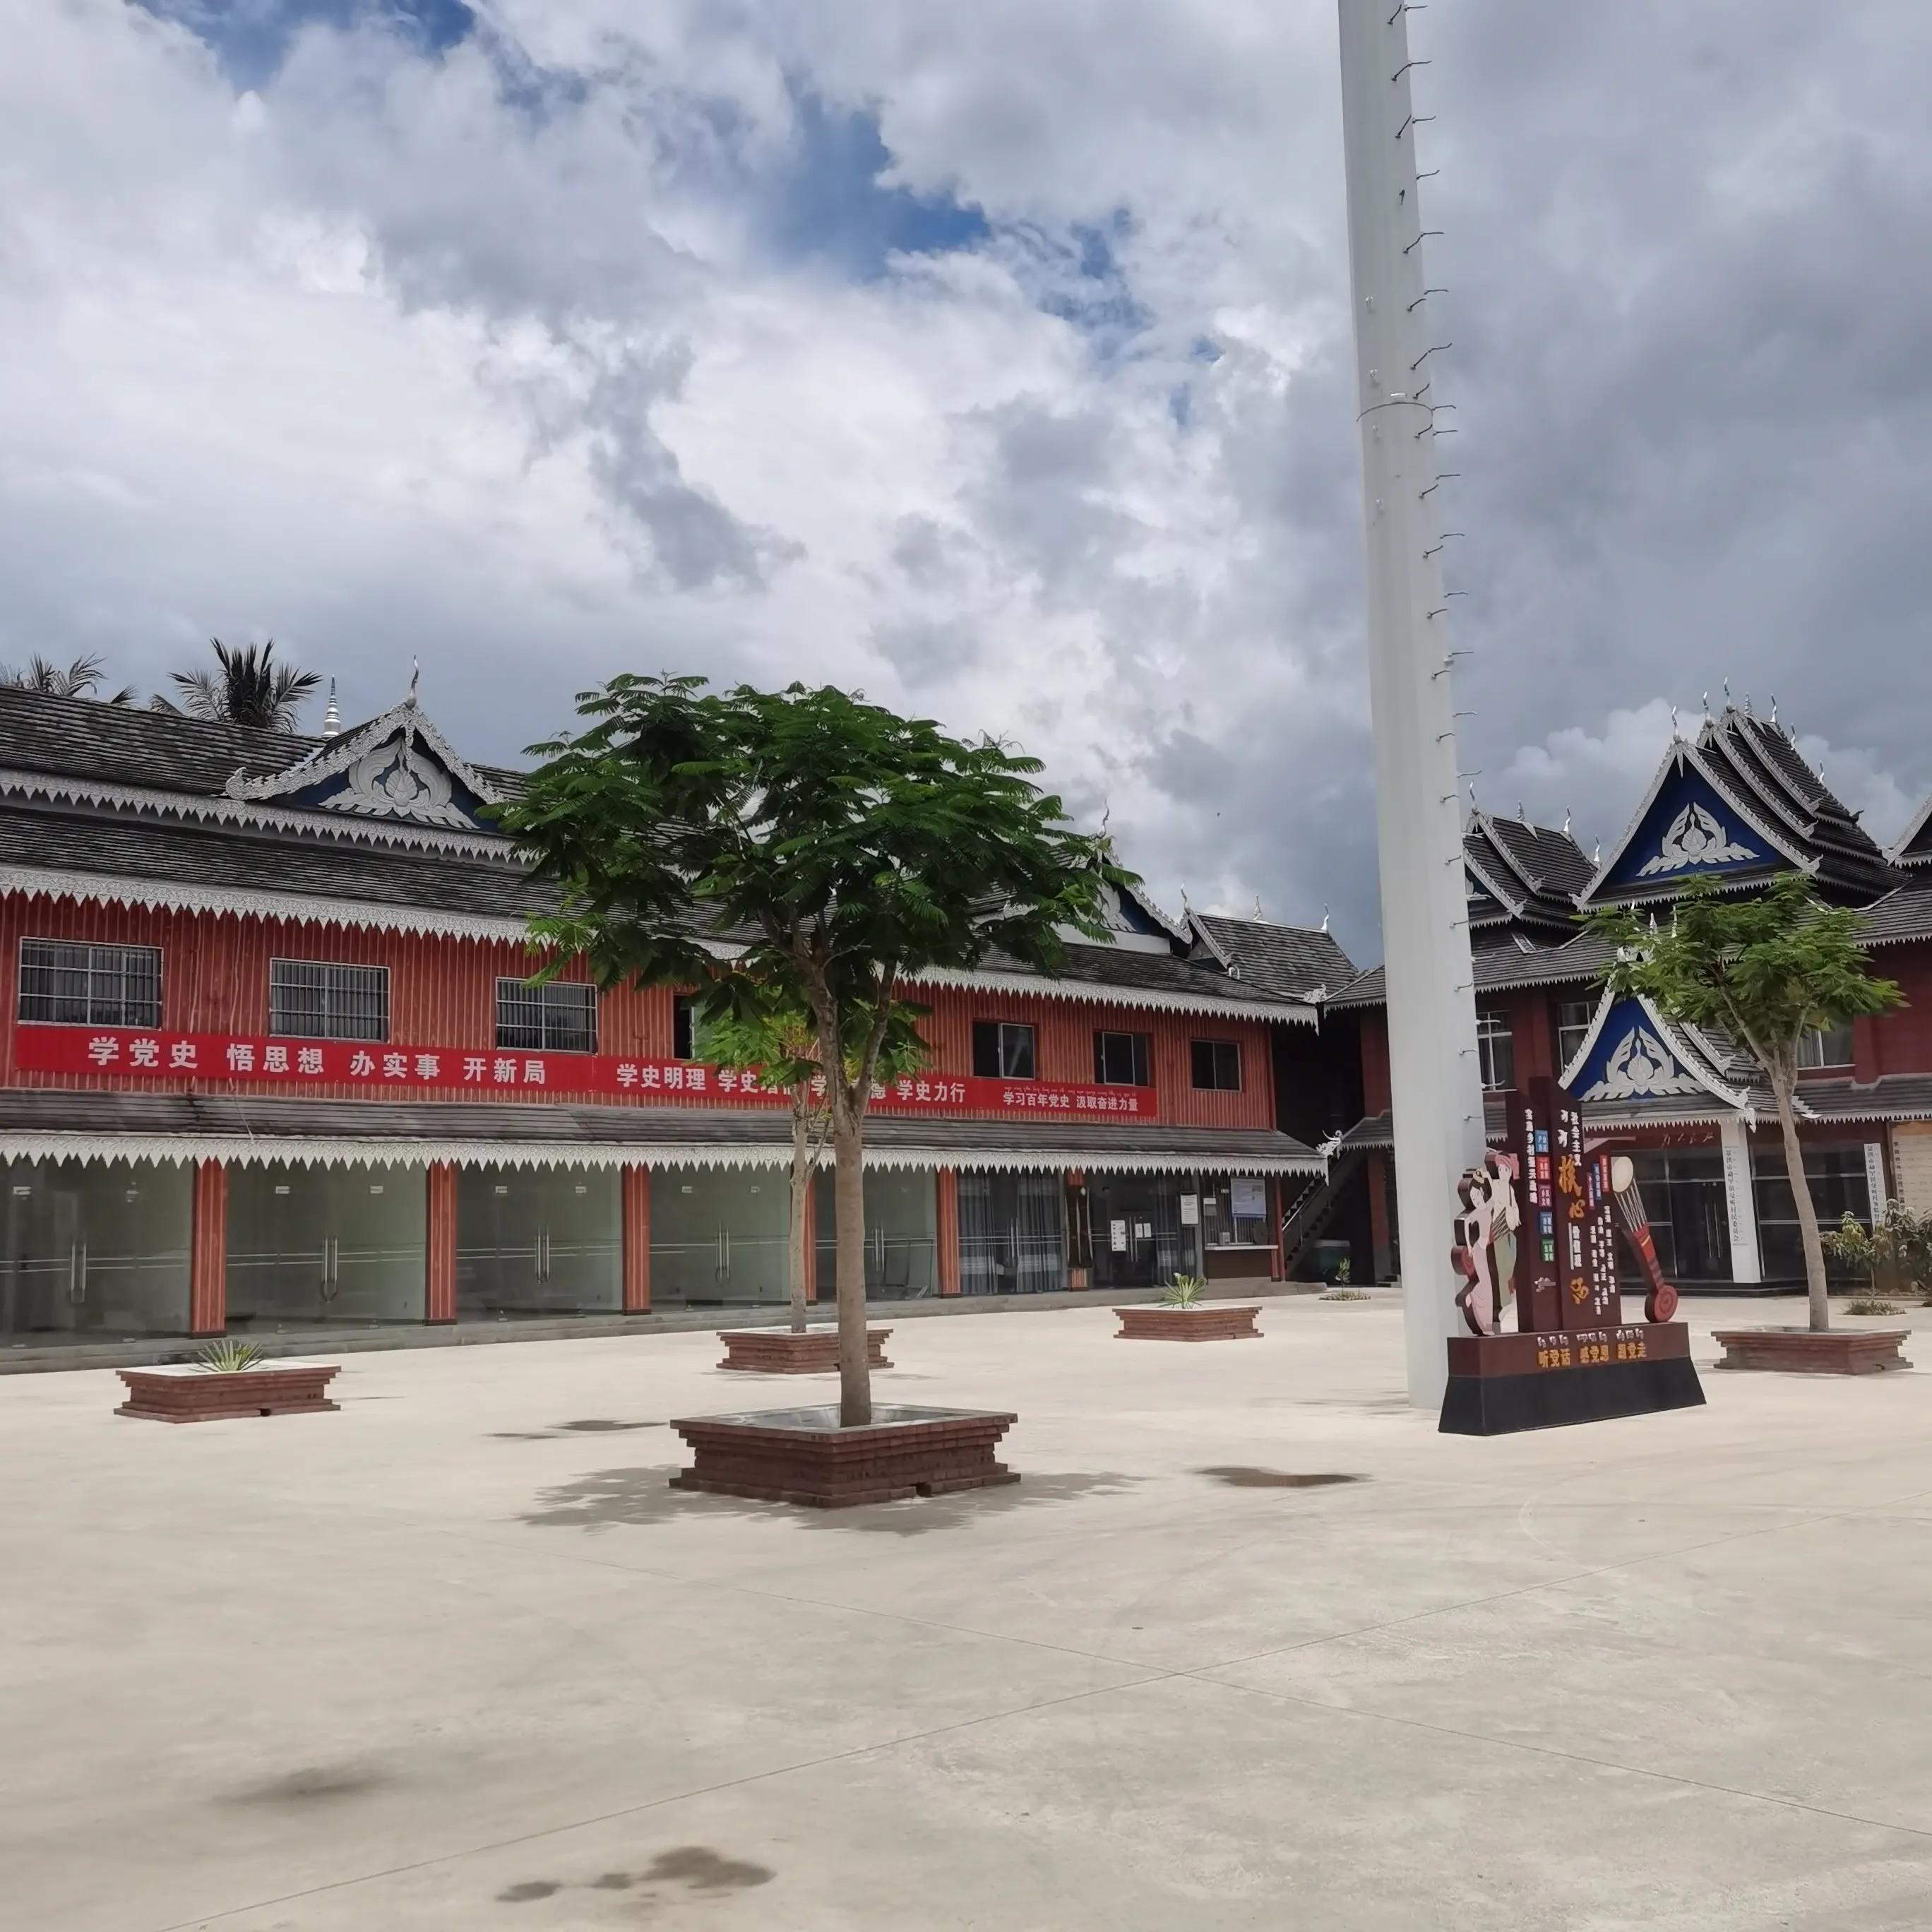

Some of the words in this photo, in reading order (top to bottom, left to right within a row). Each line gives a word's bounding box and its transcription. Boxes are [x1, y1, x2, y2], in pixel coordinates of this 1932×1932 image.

[88, 1037, 198, 1068] 学党史
[227, 1042, 325, 1074] 悟思想
[350, 1050, 441, 1080] 办实事
[463, 1055, 547, 1085] 开新局
[616, 1062, 706, 1092] 学史明理
[717, 1069, 790, 1095] 学史
[897, 1079, 966, 1104] 学史力行
[1003, 1091, 1071, 1108] 学习百年党史
[1076, 1095, 1138, 1111] 汲取奋进力量
